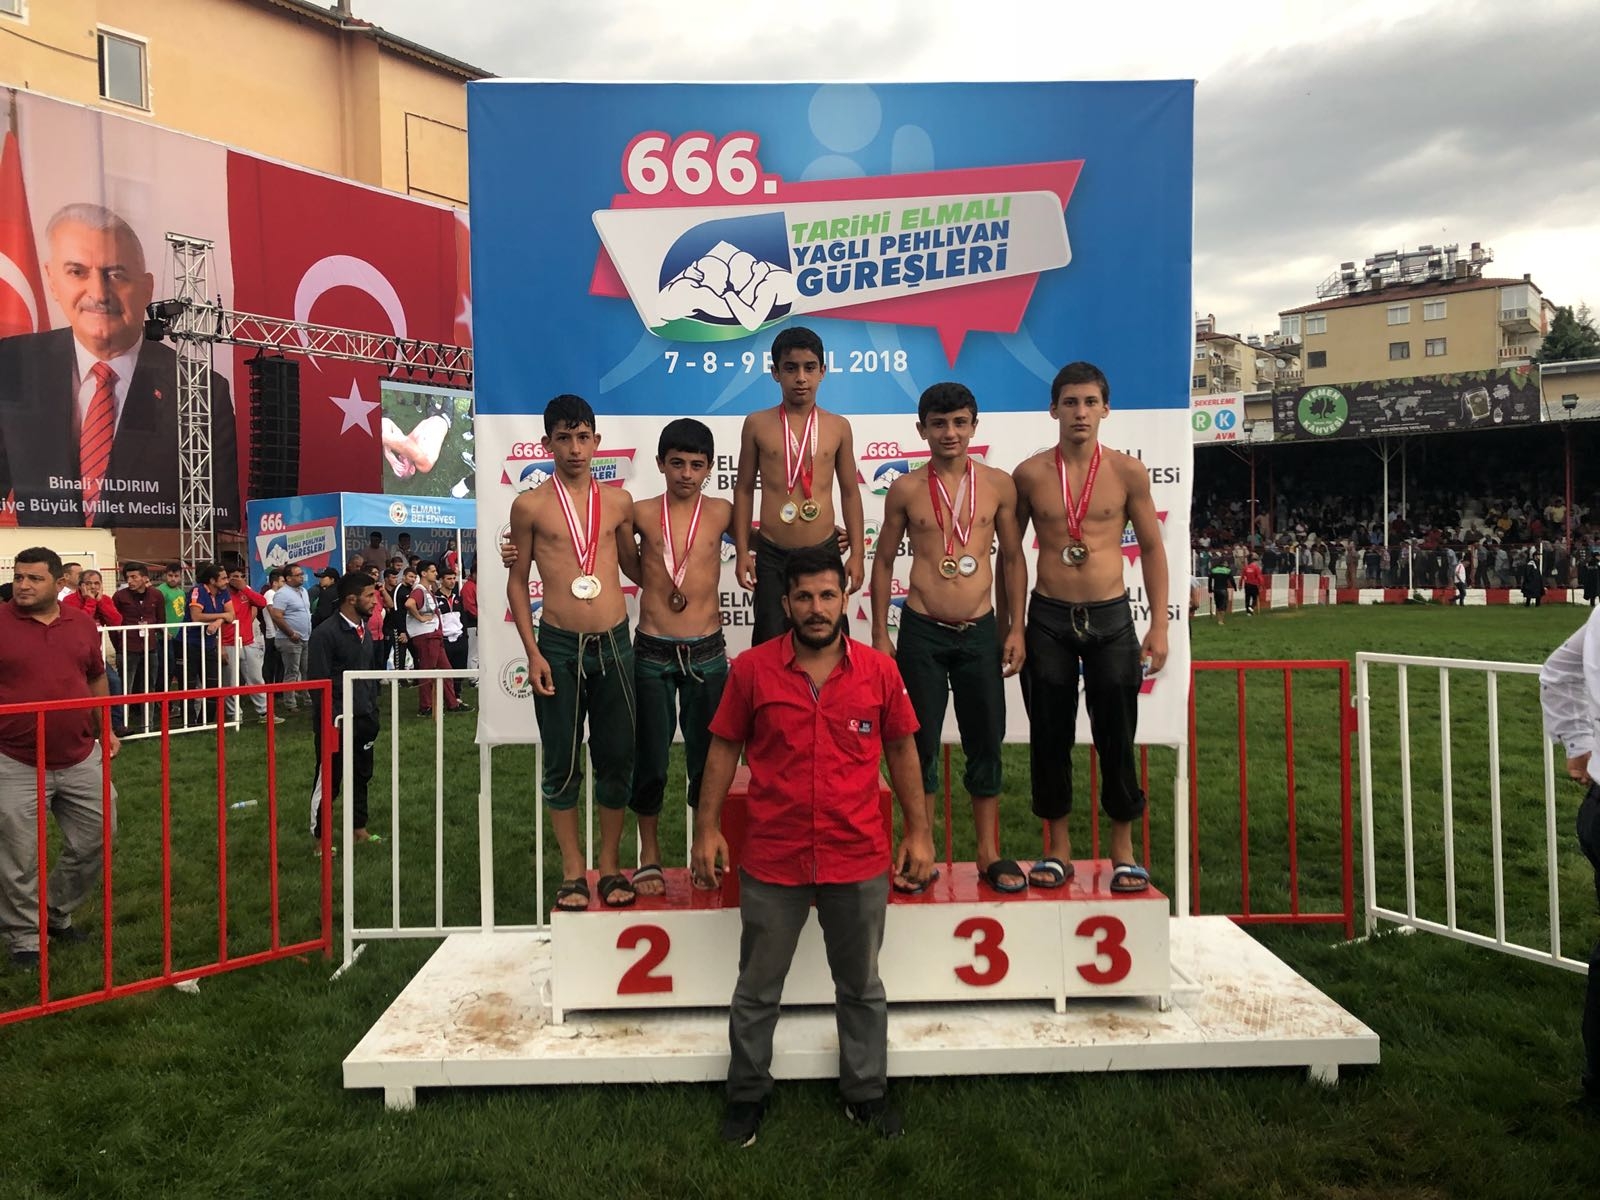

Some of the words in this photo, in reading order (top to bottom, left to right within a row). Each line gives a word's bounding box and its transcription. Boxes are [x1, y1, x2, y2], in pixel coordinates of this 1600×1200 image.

[628, 137, 777, 195] 666.
[900, 197, 1011, 230] ELMALI
[793, 239, 870, 266] YAĞLI
[664, 351, 679, 374] 7
[703, 351, 717, 373] 8
[741, 351, 755, 373] 9
[849, 350, 908, 373] 2018
[1303, 388, 1341, 402] YEMEN
[1215, 432, 1236, 440] AVM
[867, 442, 902, 457] 666.
[49, 476, 92, 490] Binali
[95, 478, 160, 493] YILDIRIM
[30, 498, 79, 515] Büyük
[82, 500, 125, 514] Millet
[128, 501, 176, 515] Meclisi
[411, 504, 441, 514] ELMALI
[260, 513, 286, 532] 666.
[616, 924, 674, 995] 2
[953, 916, 1009, 987] 3
[1075, 915, 1132, 985] 3
